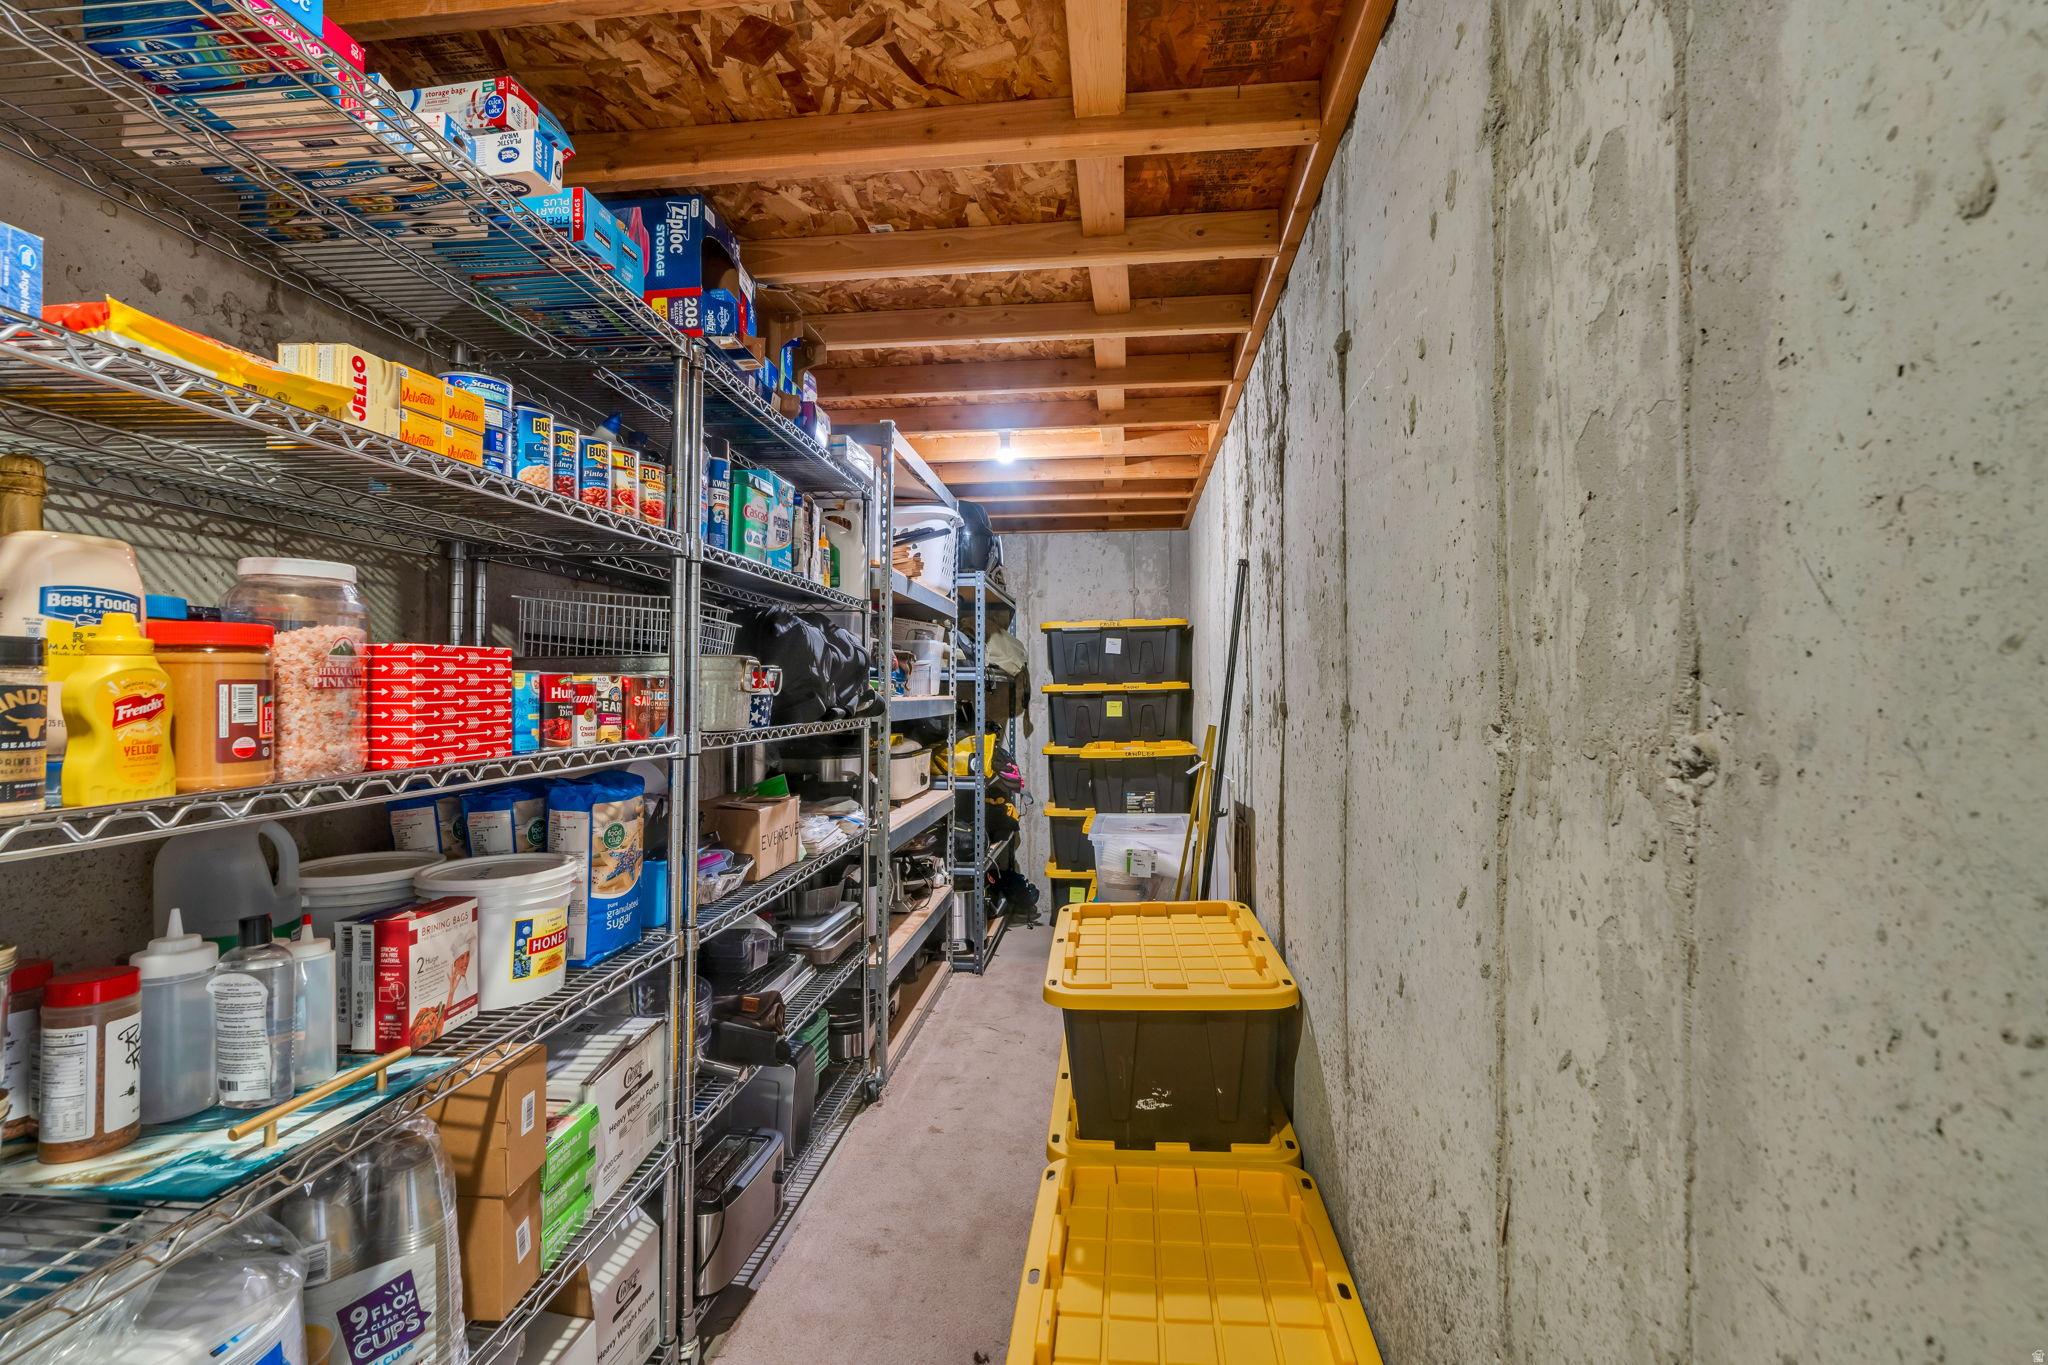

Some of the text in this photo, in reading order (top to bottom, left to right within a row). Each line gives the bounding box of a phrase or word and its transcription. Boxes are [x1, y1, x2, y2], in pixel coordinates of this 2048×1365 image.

[425, 89, 450, 99] storage
[497, 138, 521, 147] PLASTIC
[500, 132, 519, 141] WRAP
[666, 206, 684, 255] Ziploc
[655, 223, 665, 277] STORAGE
[19, 270, 31, 299] Angel
[683, 297, 698, 329] 208
[707, 309, 717, 332] Ziploc
[401, 387, 435, 406] Velveeta
[448, 404, 479, 422] Velveeta
[401, 430, 434, 448] Velveeta
[447, 444, 478, 461] Velveeta
[583, 470, 604, 478] Pinto
[47, 592, 138, 614] Best Foods
[313, 677, 345, 689] PINK
[115, 698, 164, 722] French's
[124, 744, 159, 757] YELLOW
[607, 829, 623, 837] food
[609, 835, 622, 845] club
[606, 897, 640, 921] granulated
[607, 901, 619, 910] pure
[421, 919, 451, 937] BRINING
[453, 911, 469, 923] BAGS
[606, 911, 632, 931] sugar
[532, 928, 568, 952] HONEY
[416, 956, 425, 975] 2
[608, 1081, 660, 1135] Heavy Weight Forks
[350, 1288, 416, 1331] 9 FL OZ
[371, 1313, 399, 1331] CLEAR
[354, 1312, 421, 1359] CUPS
[597, 1337, 616, 1364] Heavy
[618, 1311, 638, 1338] Weight
[383, 1343, 414, 1365] CUPS
